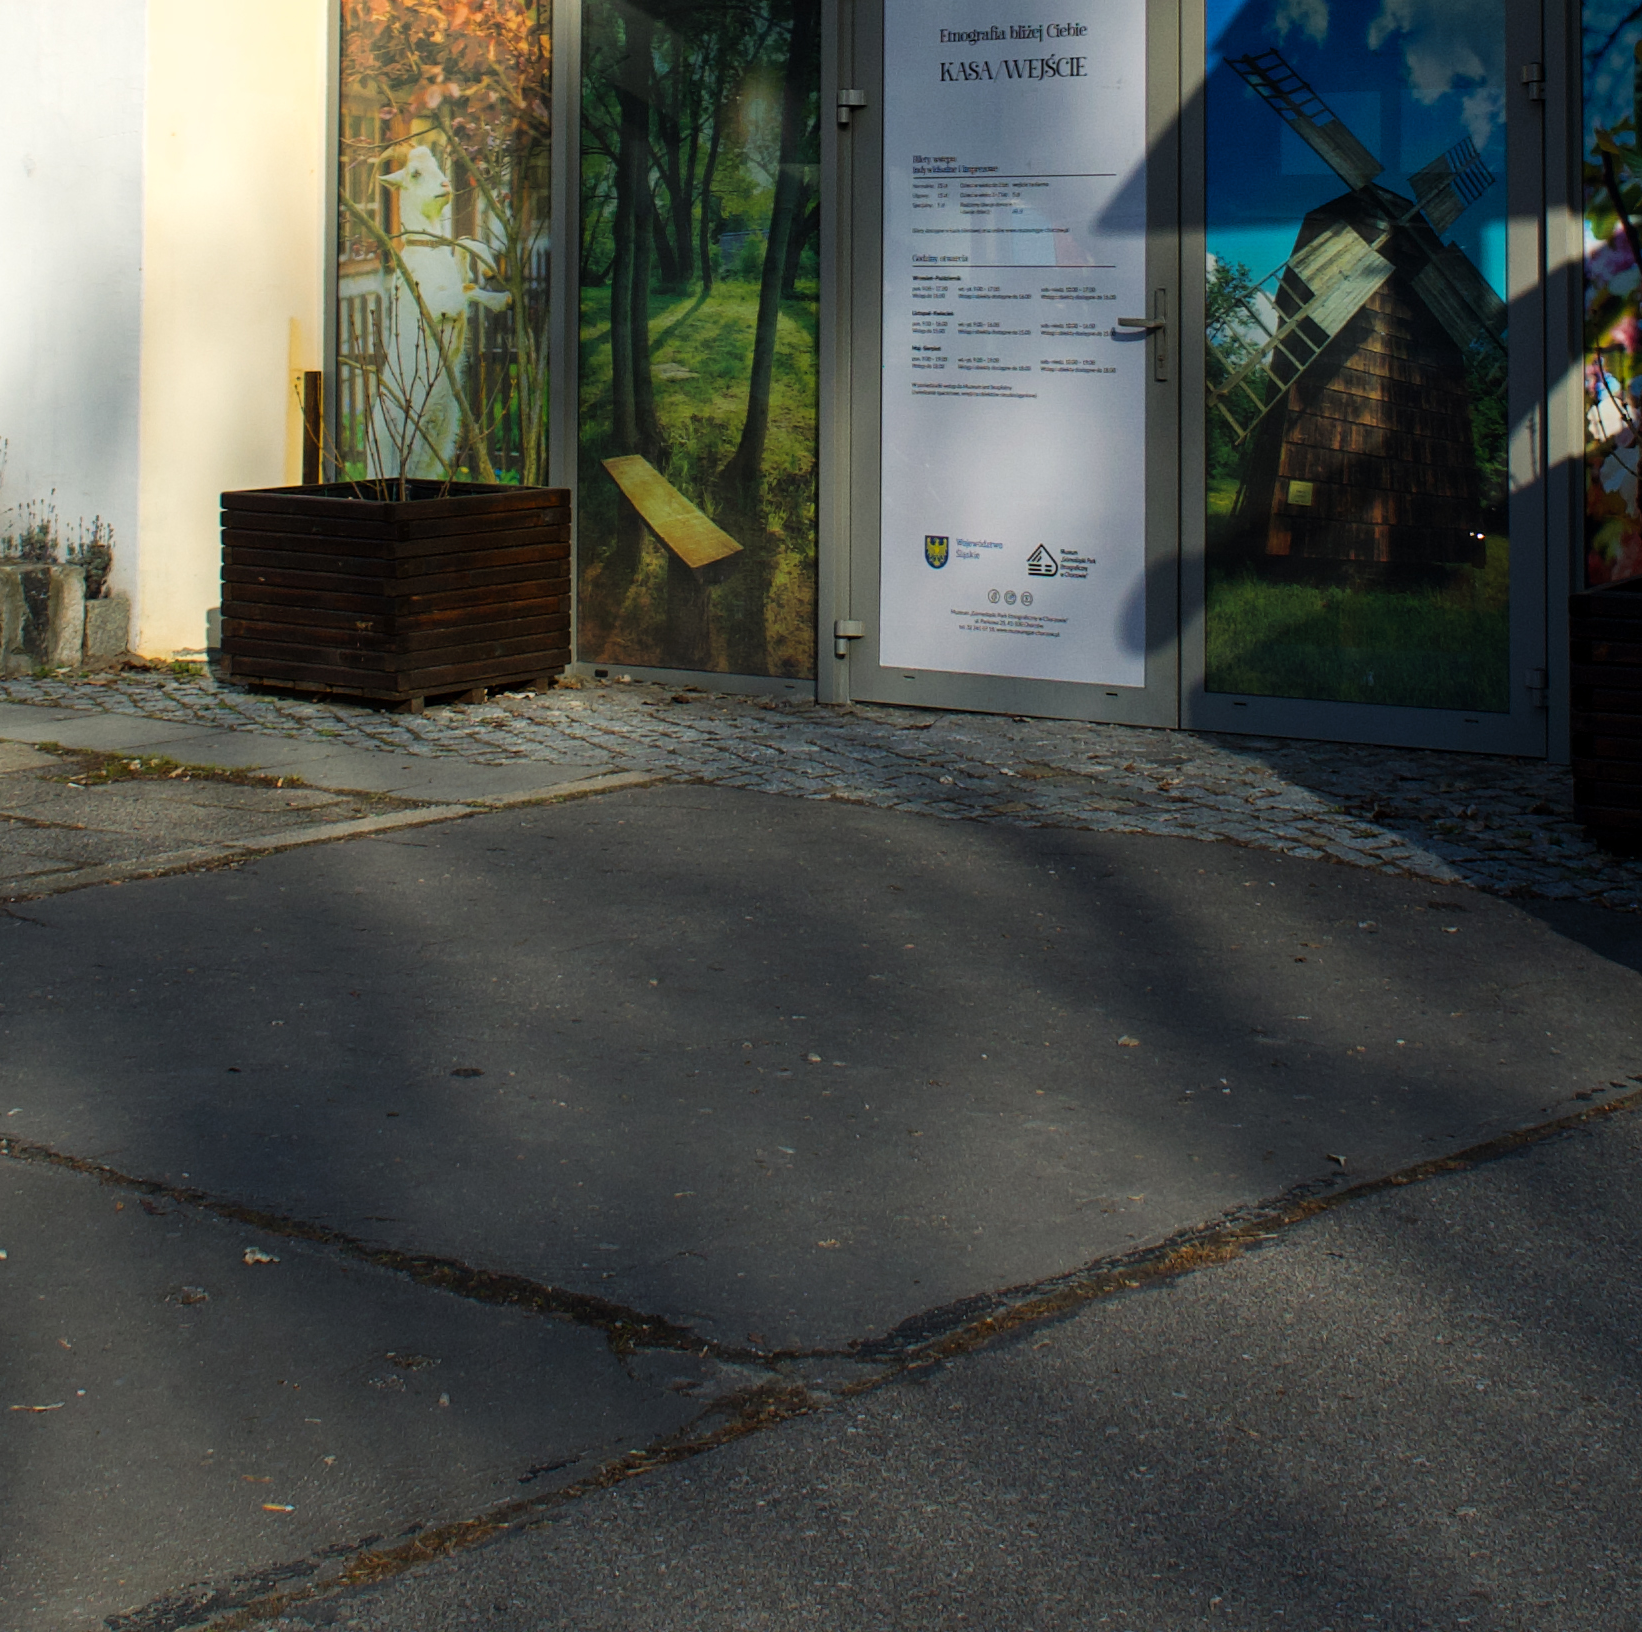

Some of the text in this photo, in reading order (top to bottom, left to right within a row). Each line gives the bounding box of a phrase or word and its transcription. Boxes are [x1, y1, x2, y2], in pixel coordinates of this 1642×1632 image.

[940, 22, 1088, 46] Etnografia bliżej Ciebie
